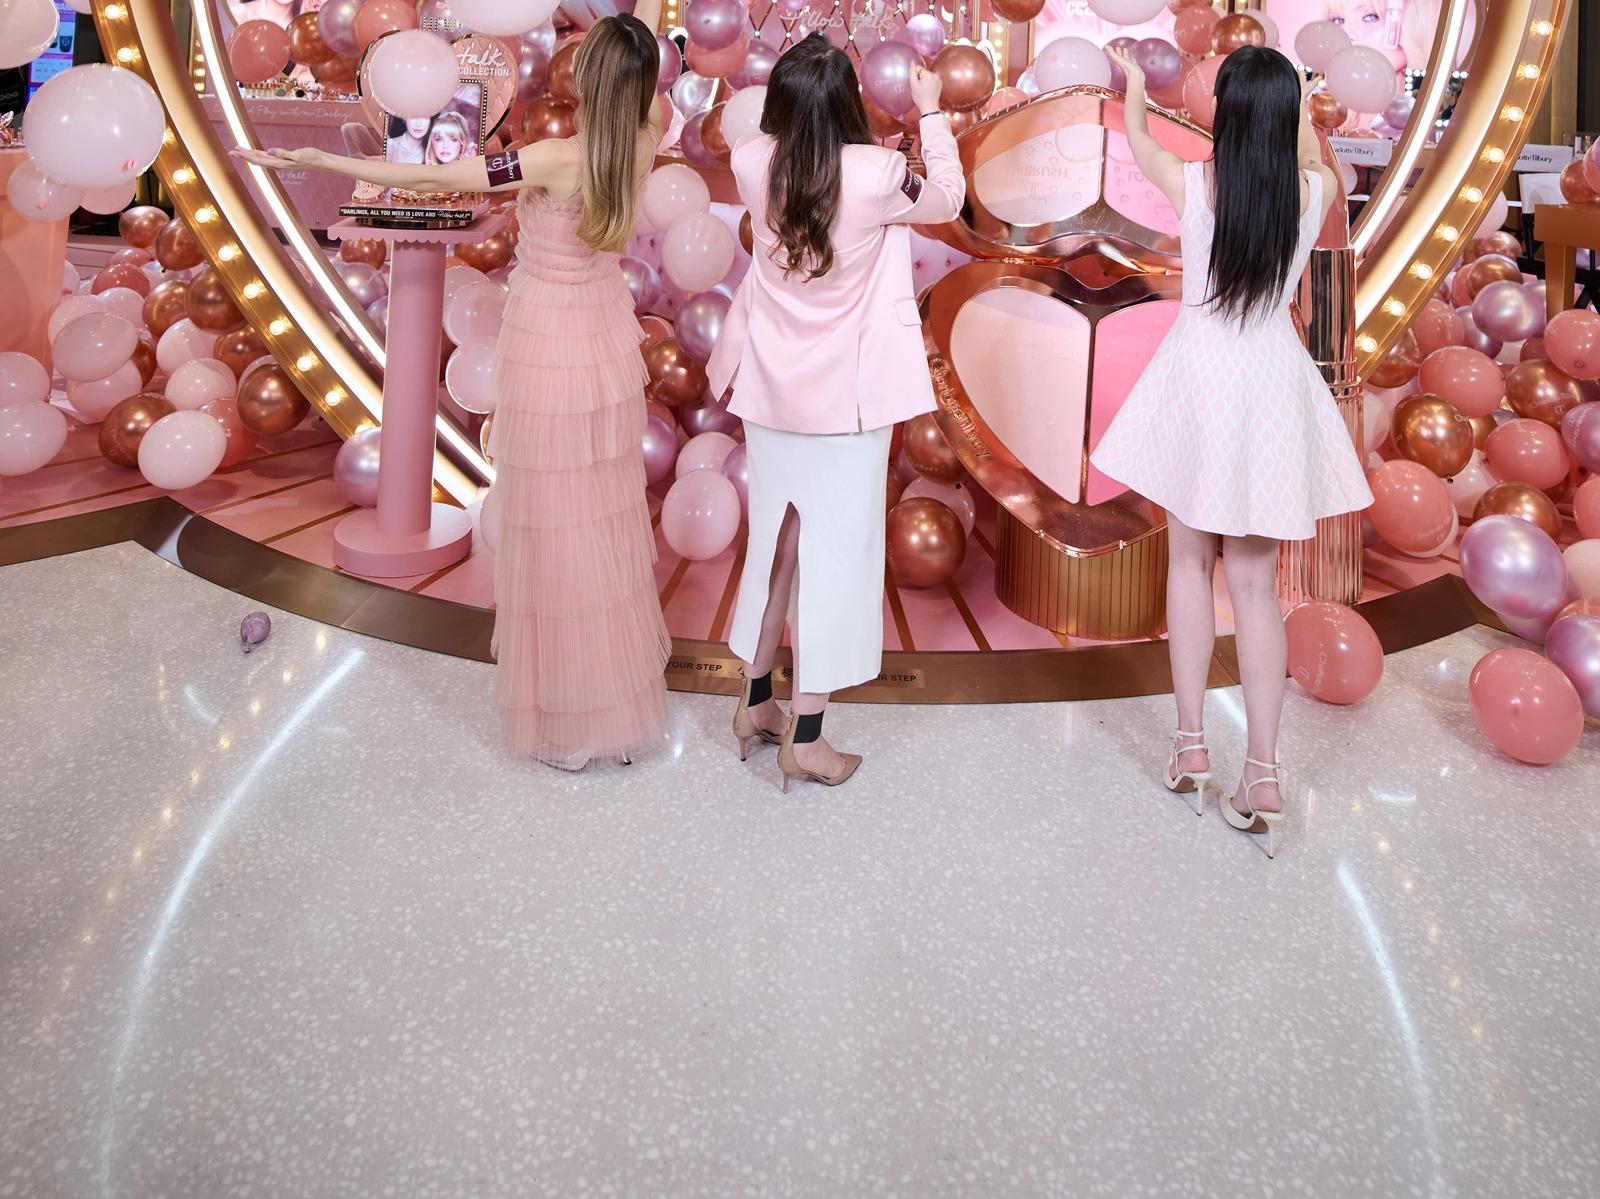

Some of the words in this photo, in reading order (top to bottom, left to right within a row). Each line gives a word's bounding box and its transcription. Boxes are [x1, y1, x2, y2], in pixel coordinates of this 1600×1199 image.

[456, 46, 505, 68] talk
[458, 67, 509, 77] COLLECTION
[696, 663, 722, 672] STEP
[891, 674, 917, 682] STEP
